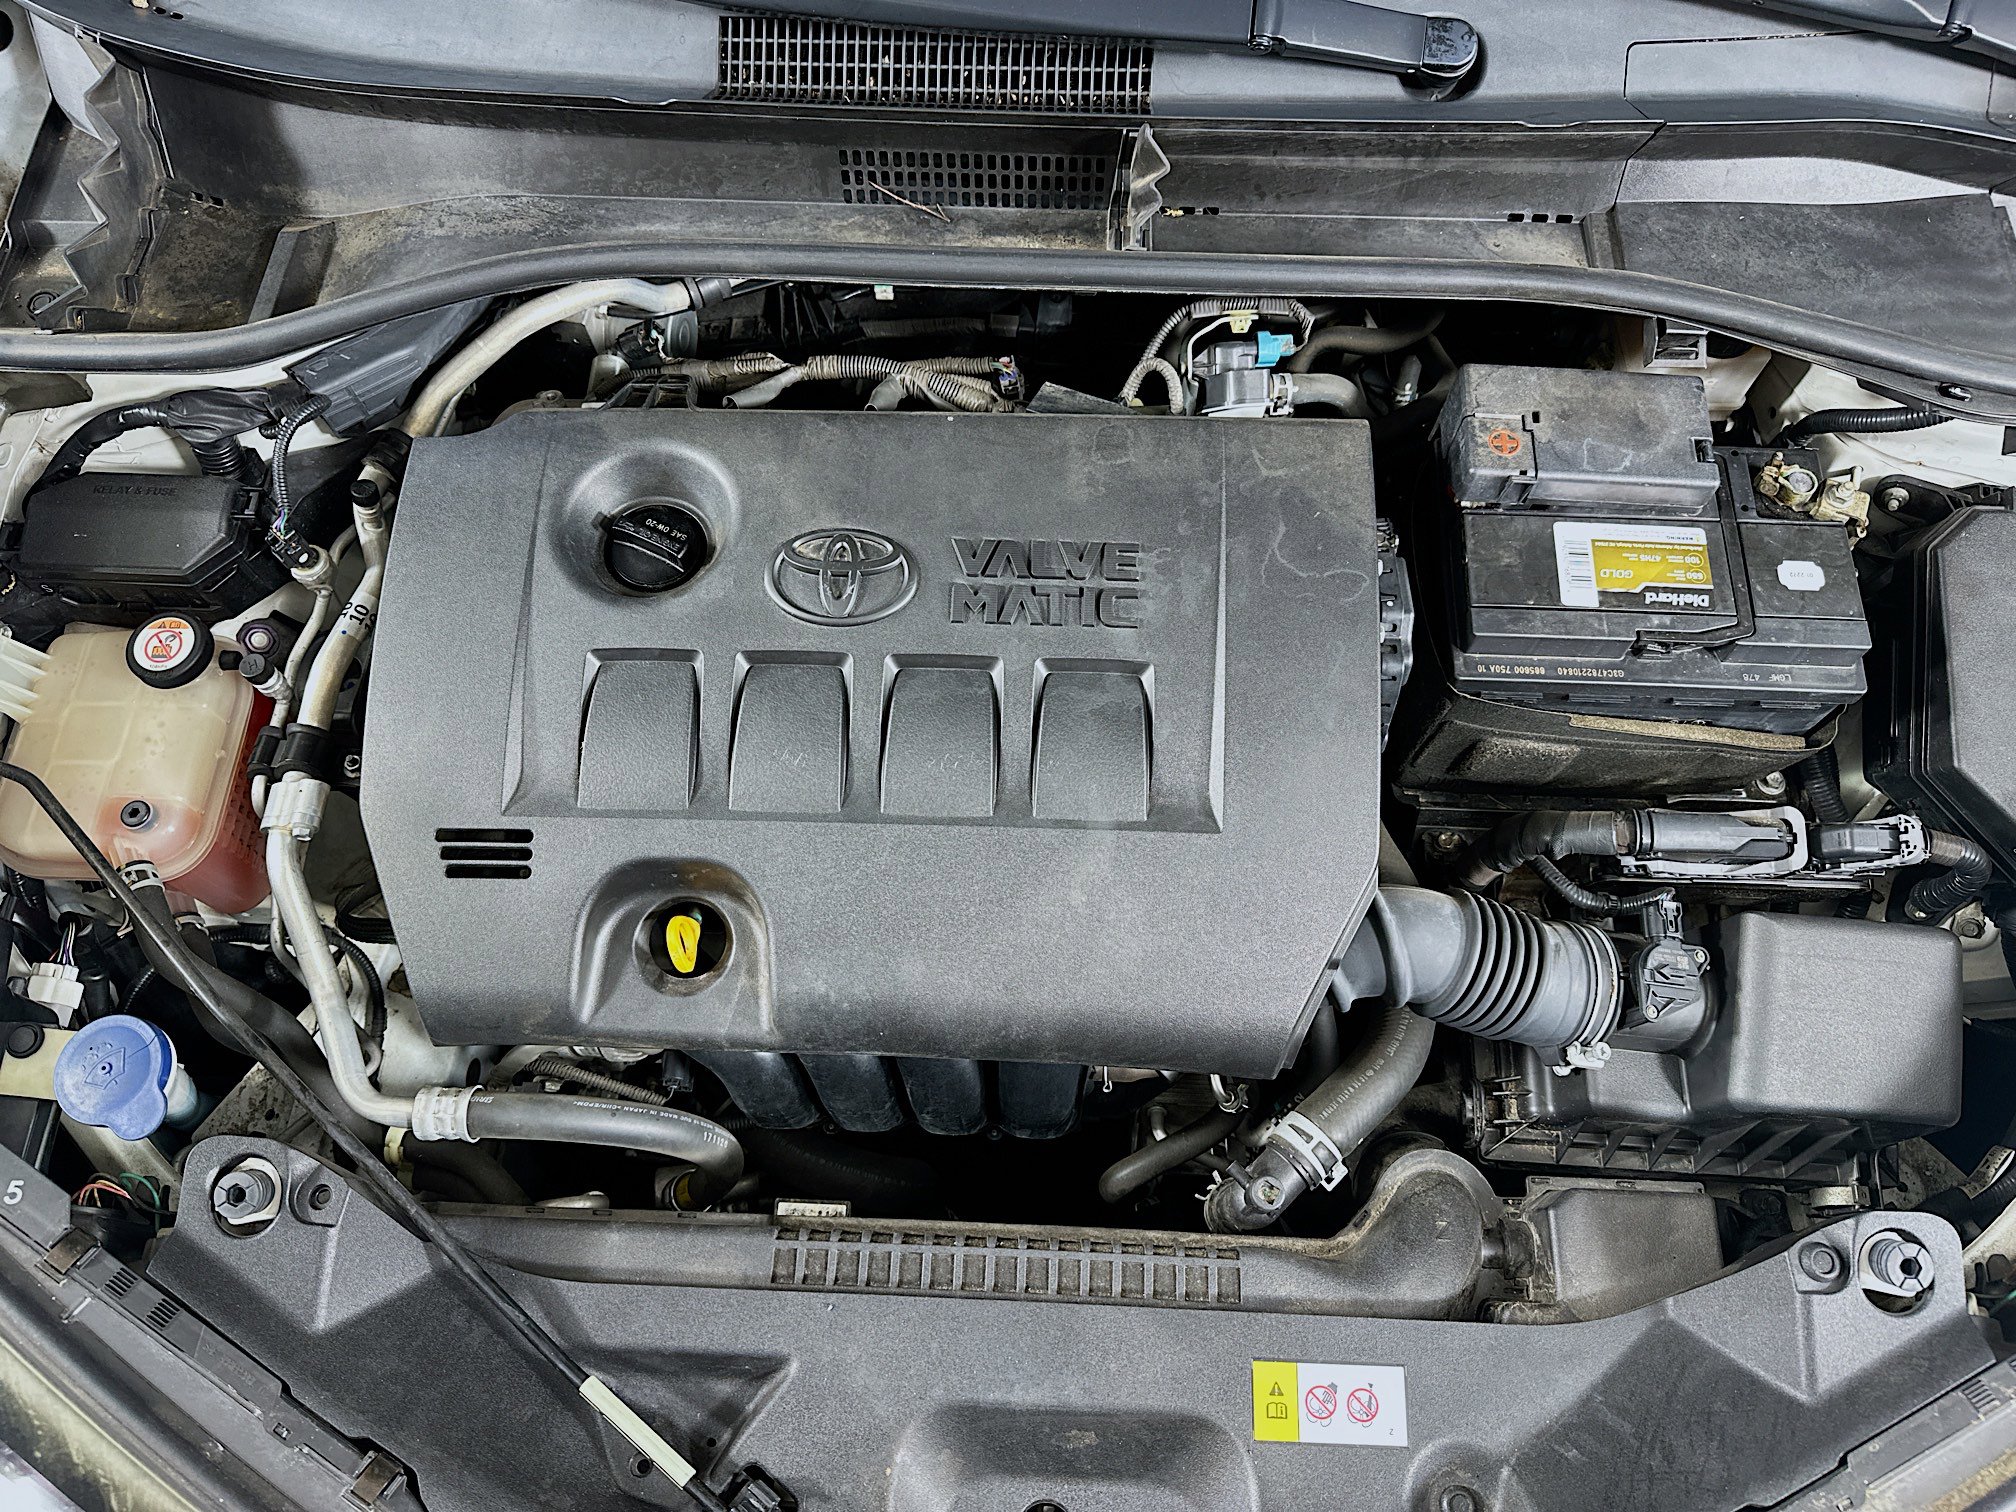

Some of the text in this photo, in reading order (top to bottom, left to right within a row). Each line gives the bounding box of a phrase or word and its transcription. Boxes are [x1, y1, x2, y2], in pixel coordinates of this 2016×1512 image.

[93, 485, 133, 495] RELAY
[145, 486, 178, 496] FUSE
[645, 518, 688, 541] SAE 0W-20
[951, 538, 1140, 582] VALVE
[1600, 568, 1633, 579] GOLD
[951, 583, 1139, 629] MATIC
[1644, 592, 1710, 607] DieHard
[350, 604, 369, 626] 10
[1477, 664, 1487, 673] 10
[1489, 664, 1511, 674] 750A
[623, 1105, 648, 1114] JAPAN
[659, 1111, 678, 1120] MADE
[3, 1179, 25, 1205] 5
